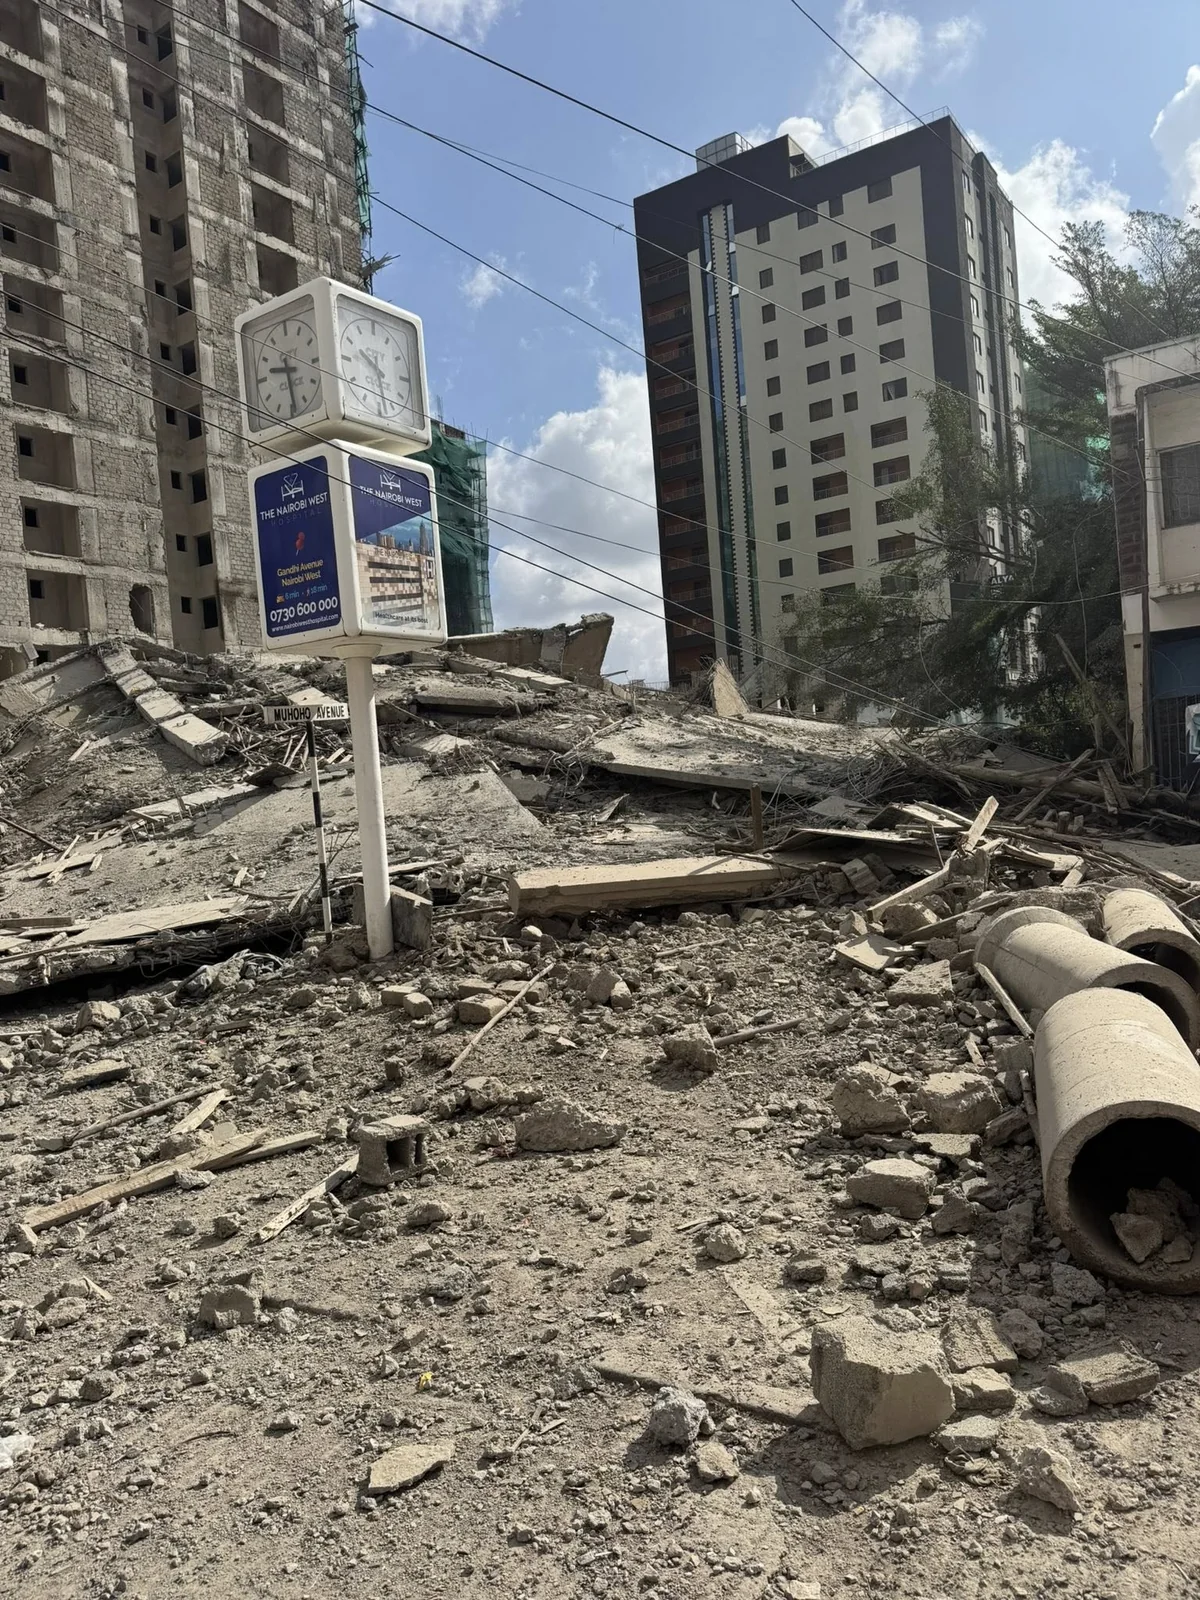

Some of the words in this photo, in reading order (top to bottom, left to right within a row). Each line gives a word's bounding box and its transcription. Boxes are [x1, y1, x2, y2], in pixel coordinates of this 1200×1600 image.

[260, 509, 276, 521] THE
[276, 500, 308, 517] NAIROBI
[308, 492, 328, 506] WEST
[375, 490, 404, 504] NAIROBI
[404, 496, 422, 507] WEST
[277, 563, 299, 577] Gandhi
[300, 559, 324, 570] Avenue
[281, 573, 304, 587] Nairobi
[304, 570, 322, 581] West
[289, 590, 300, 599] min
[318, 583, 328, 593] min
[270, 606, 296, 623] 0730
[296, 601, 317, 616] 600
[318, 596, 338, 611] 000
[375, 611, 404, 621] Healthcare
[271, 613, 339, 632] www.nairobiwesthospital.com
[274, 707, 311, 721] MUHOHO
[316, 705, 345, 719] AVENUE
